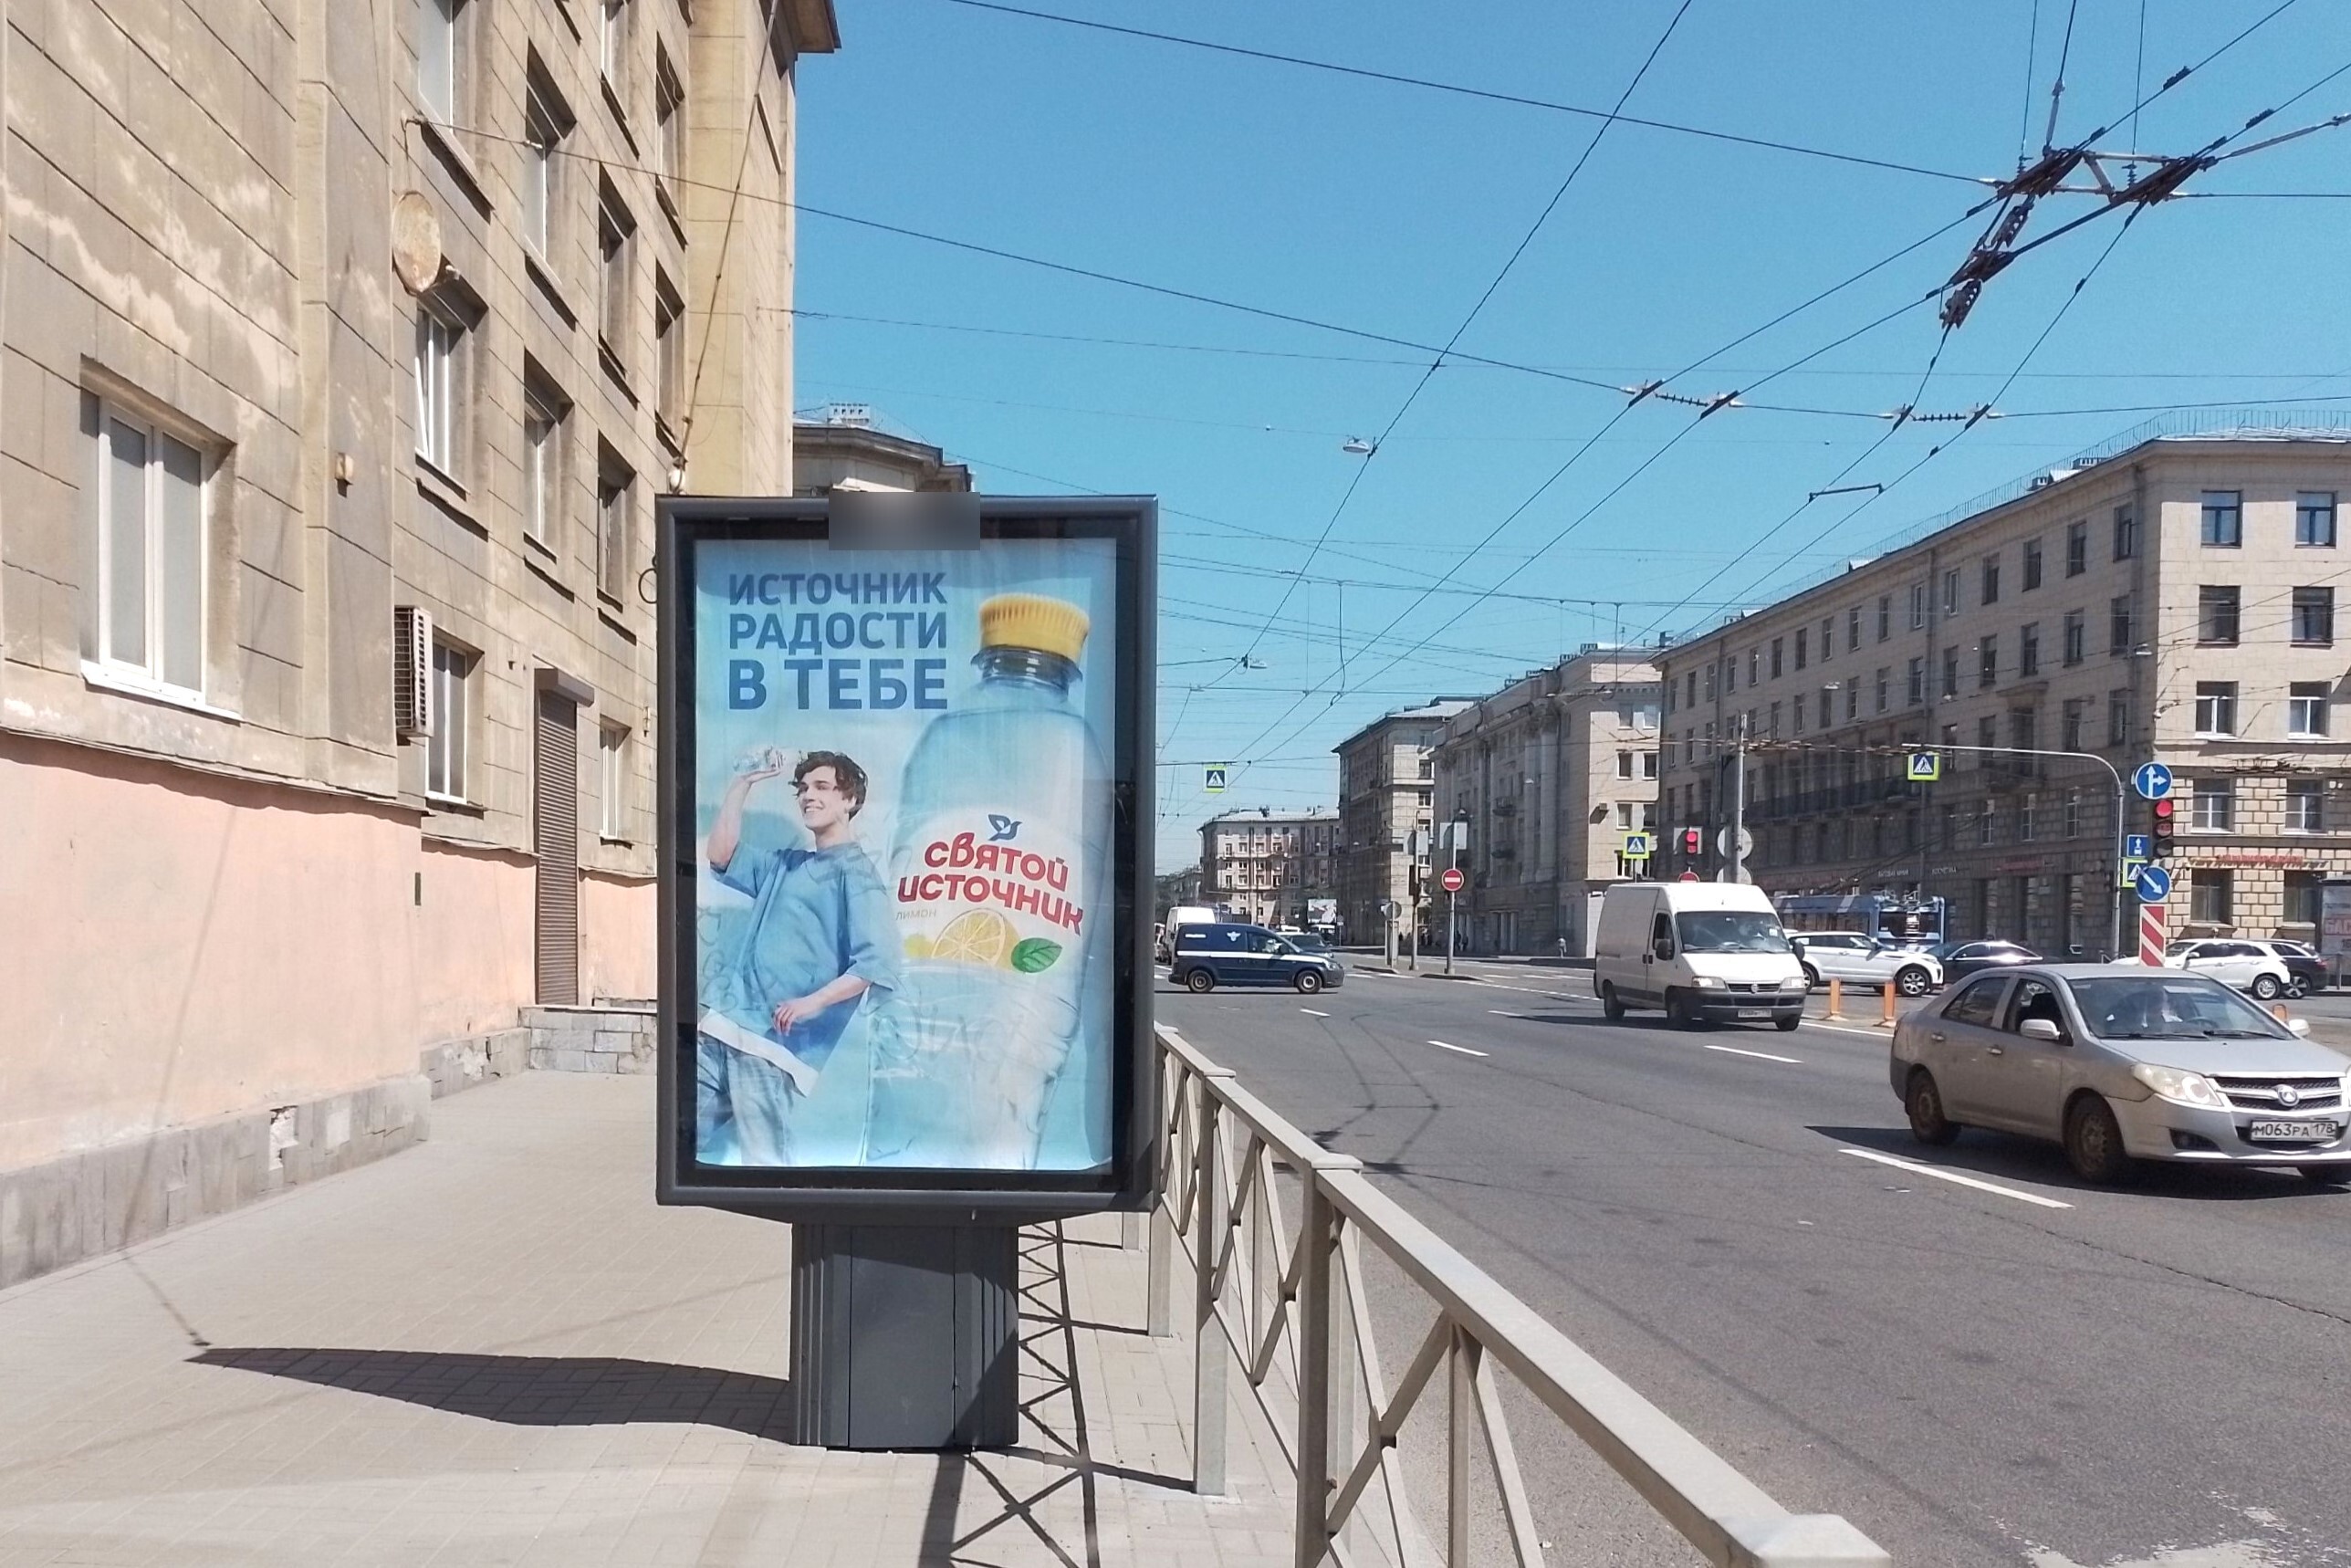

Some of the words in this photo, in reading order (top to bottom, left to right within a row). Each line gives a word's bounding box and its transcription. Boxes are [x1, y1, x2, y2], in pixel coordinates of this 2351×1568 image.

[729, 572, 947, 606] ИСТОЧНИК
[729, 612, 947, 656] РАДОСТИ
[728, 659, 768, 710] В
[785, 659, 948, 710] ТЕБЕ
[895, 908, 937, 921] ЛИМОН
